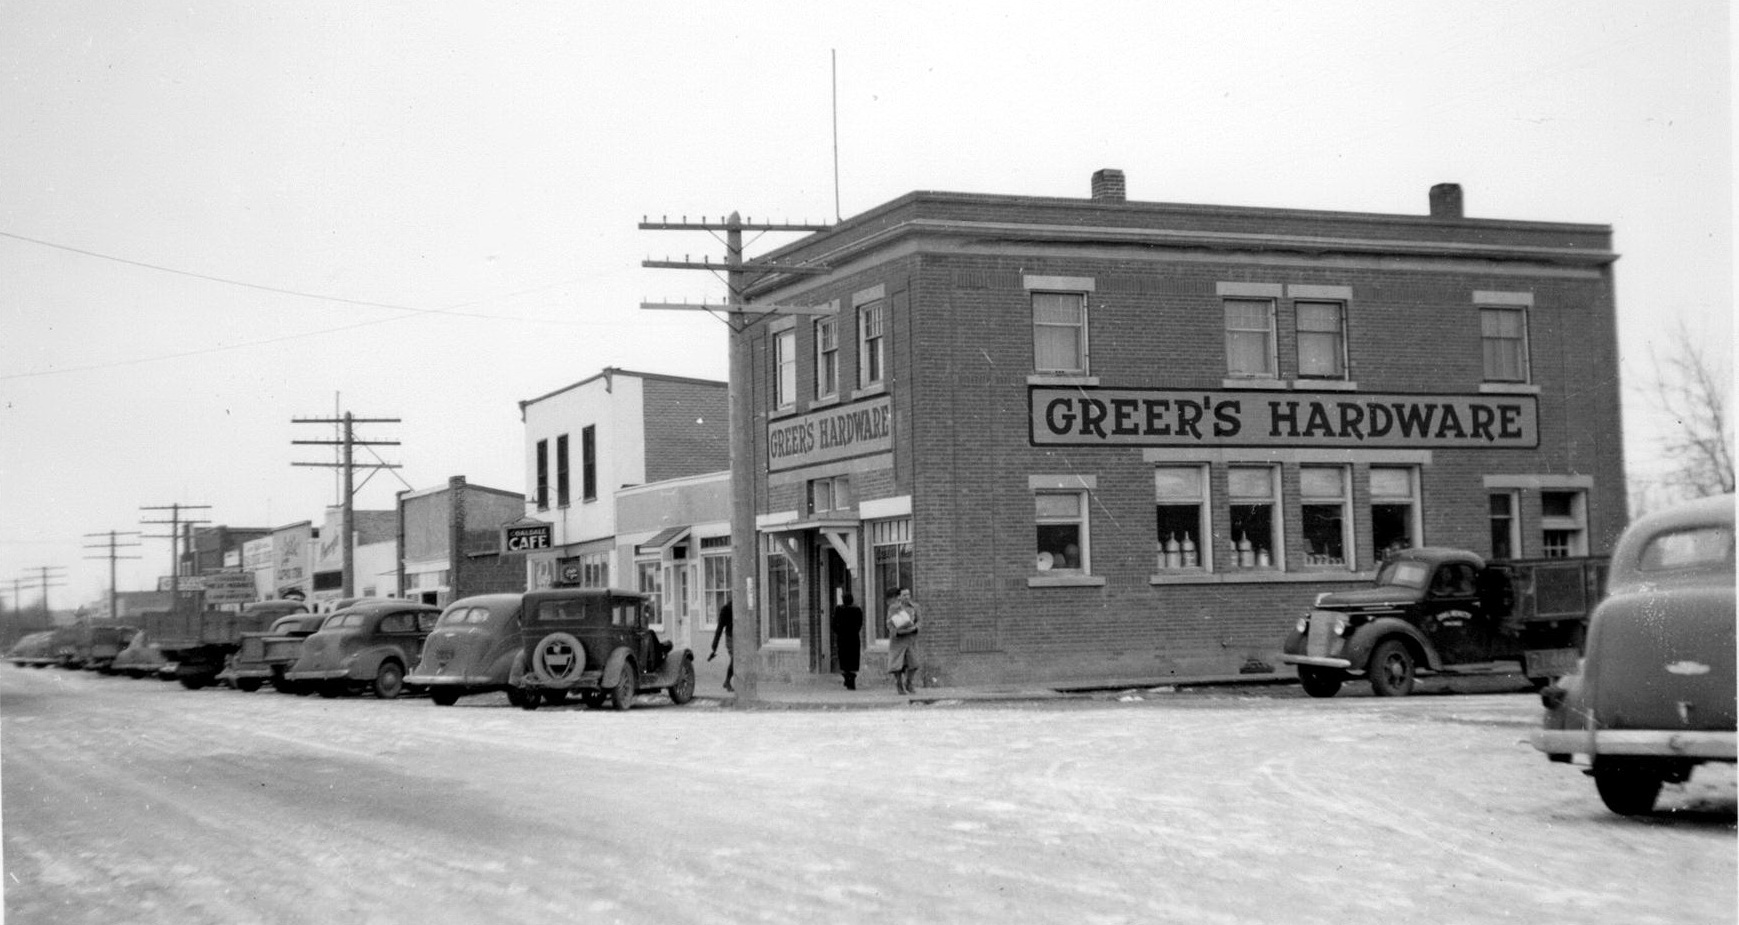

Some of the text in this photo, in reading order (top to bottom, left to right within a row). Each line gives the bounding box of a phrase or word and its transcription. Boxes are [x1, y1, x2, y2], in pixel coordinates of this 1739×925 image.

[770, 405, 889, 458] GREER'S HARDWARE
[1046, 396, 1522, 441] GREER'S HARDWARE
[509, 534, 547, 551] CAFE
